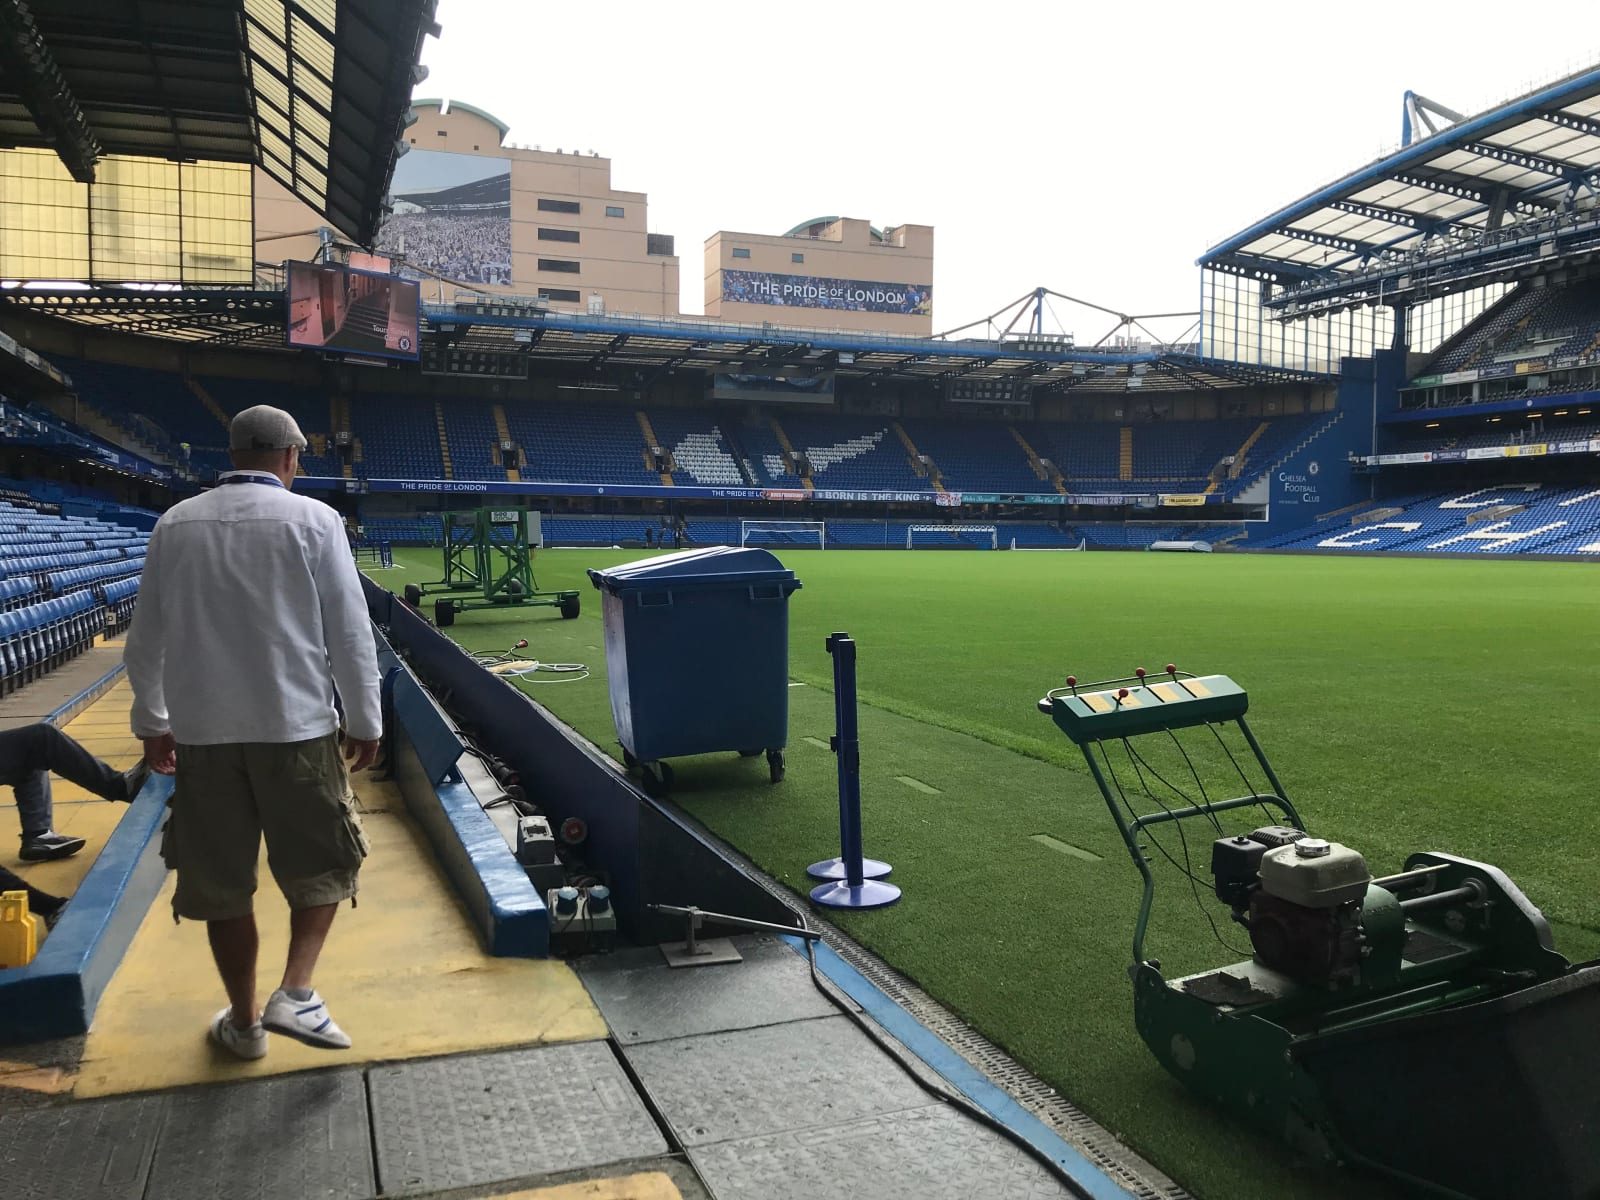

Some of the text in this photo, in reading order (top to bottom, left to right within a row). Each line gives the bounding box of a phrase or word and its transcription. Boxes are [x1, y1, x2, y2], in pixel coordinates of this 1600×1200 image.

[752, 281, 906, 304] THE PRIDE OF LONDON
[1279, 472, 1306, 482] CHELSEA
[1284, 482, 1317, 492] FOOTBALL
[825, 491, 920, 502] BORN IS THE KING
[1302, 493, 1320, 503] CLUB
